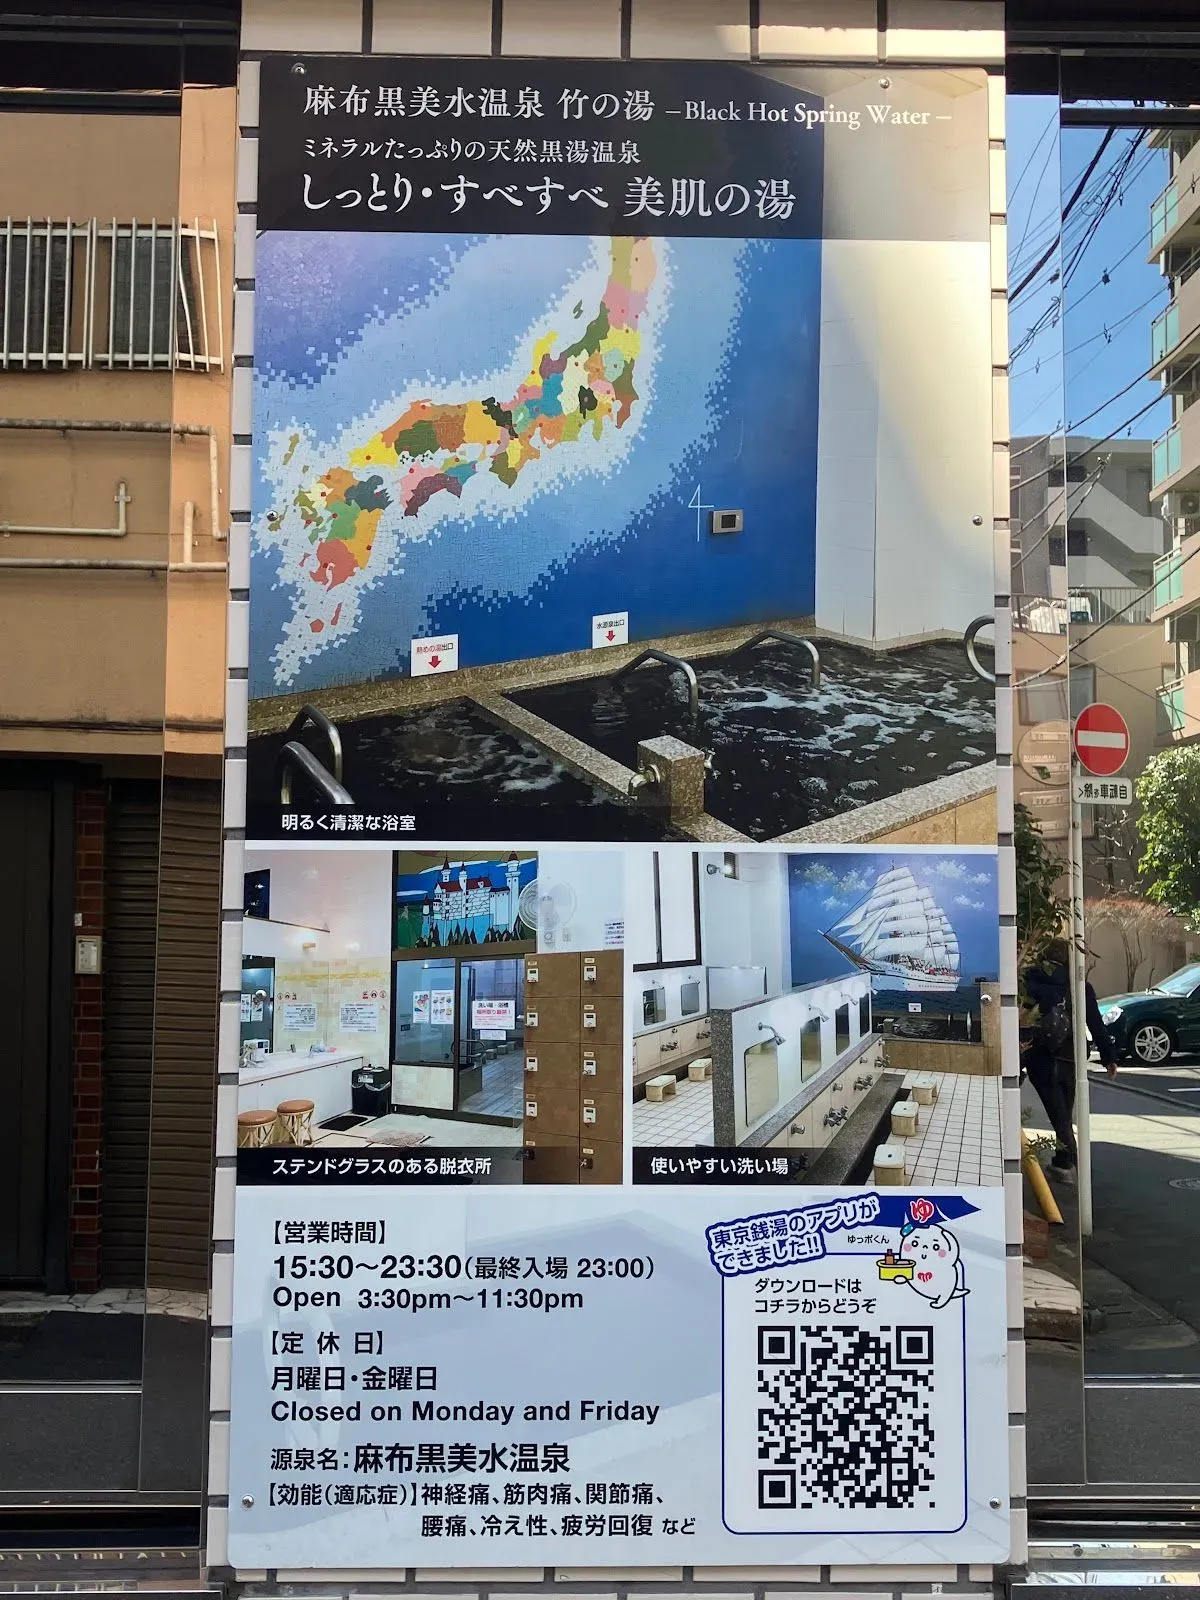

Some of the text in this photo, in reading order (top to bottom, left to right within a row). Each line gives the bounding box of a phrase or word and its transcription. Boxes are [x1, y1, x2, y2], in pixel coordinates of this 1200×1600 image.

[303, 85, 655, 122] 麻布黒美水温泉 竹の湯
[747, 103, 789, 123] Hot
[794, 102, 861, 130] Spring
[303, 137, 642, 165] ミネラルたっぷりの天然黒湯温泉
[302, 172, 797, 220] しっとり・すべすべ 美肌の湯
[281, 814, 416, 831] 明るく清潔な浴室
[272, 1157, 492, 1176] ステンドグラスのある脱衣所
[650, 1156, 789, 1176] 使いやすい洗い場
[910, 1198, 934, 1222] ゆ
[273, 1220, 386, 1245] 【営業時間】
[711, 1198, 880, 1251] 東京銭湯のアプリが
[847, 1234, 890, 1245] ゆっポくん
[272, 1286, 341, 1311] Open
[754, 1278, 863, 1294] ダウンロードは
[754, 1299, 877, 1315] コチラからどうぞ
[271, 1365, 437, 1391] 月曜日・金曜日
[271, 1400, 660, 1426] Closed on Monday and Friday
[421, 1514, 696, 1537] 腰痛、冷え性、疲労回復 など
